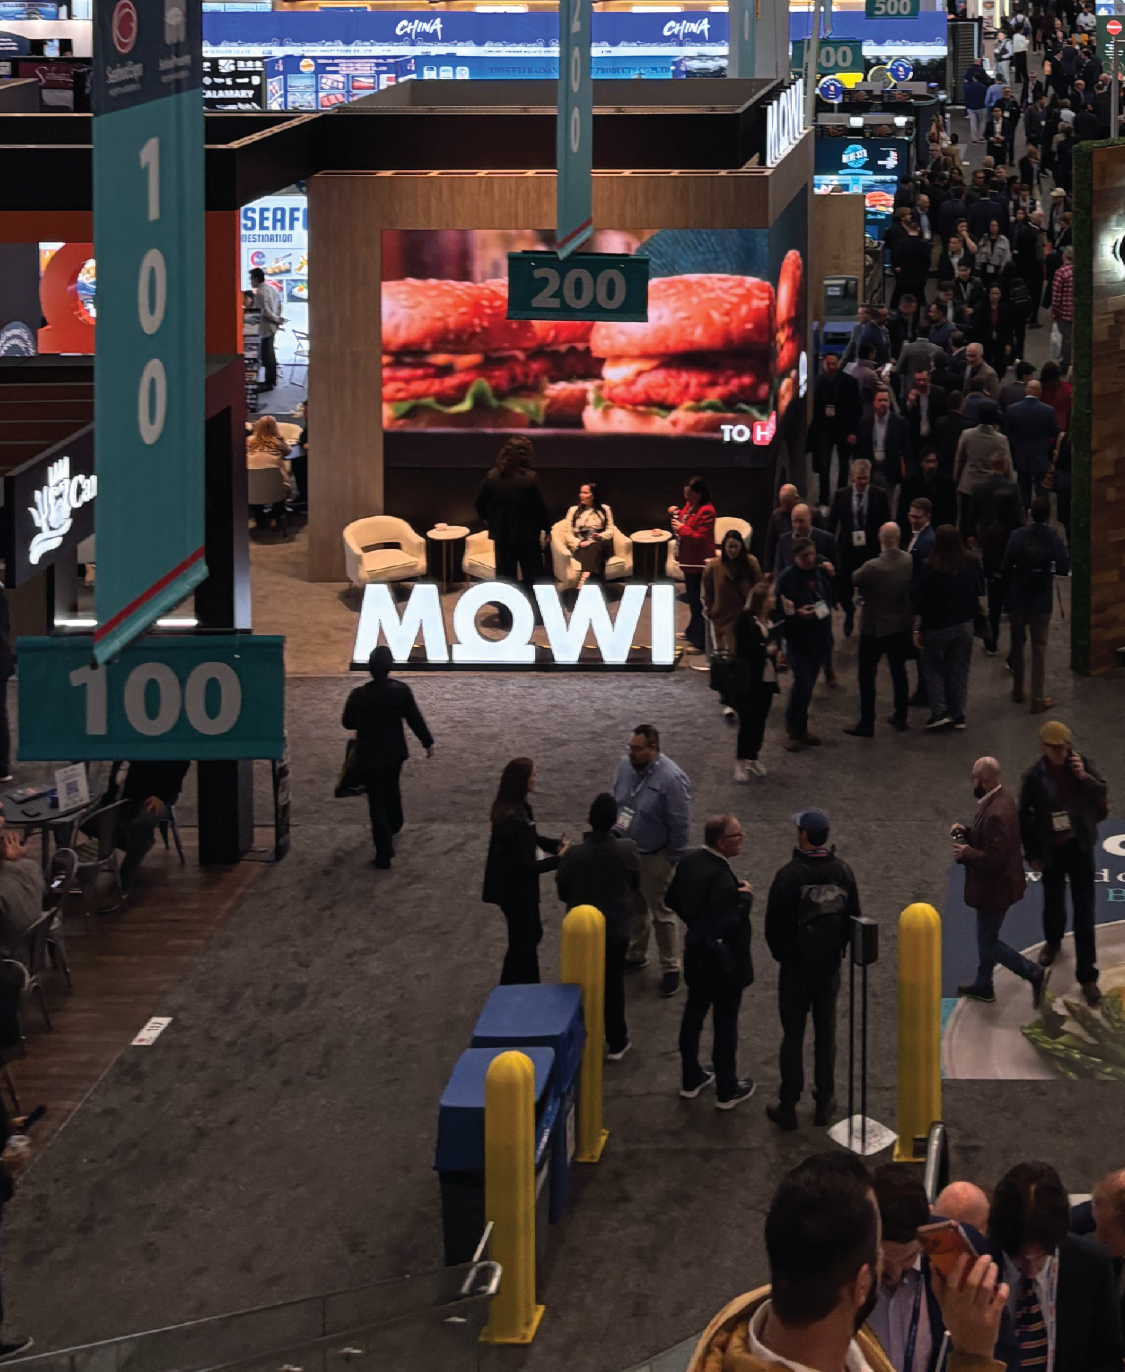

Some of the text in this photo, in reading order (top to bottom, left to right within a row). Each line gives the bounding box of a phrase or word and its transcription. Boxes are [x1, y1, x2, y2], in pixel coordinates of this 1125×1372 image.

[395, 17, 443, 40] CHINA
[662, 17, 711, 41] CHINA
[819, 46, 853, 67] 00
[241, 233, 293, 243] DESTINATION
[530, 268, 627, 309] 200
[720, 424, 751, 442] TO
[353, 582, 675, 664] MOWI
[69, 661, 242, 737] 100
